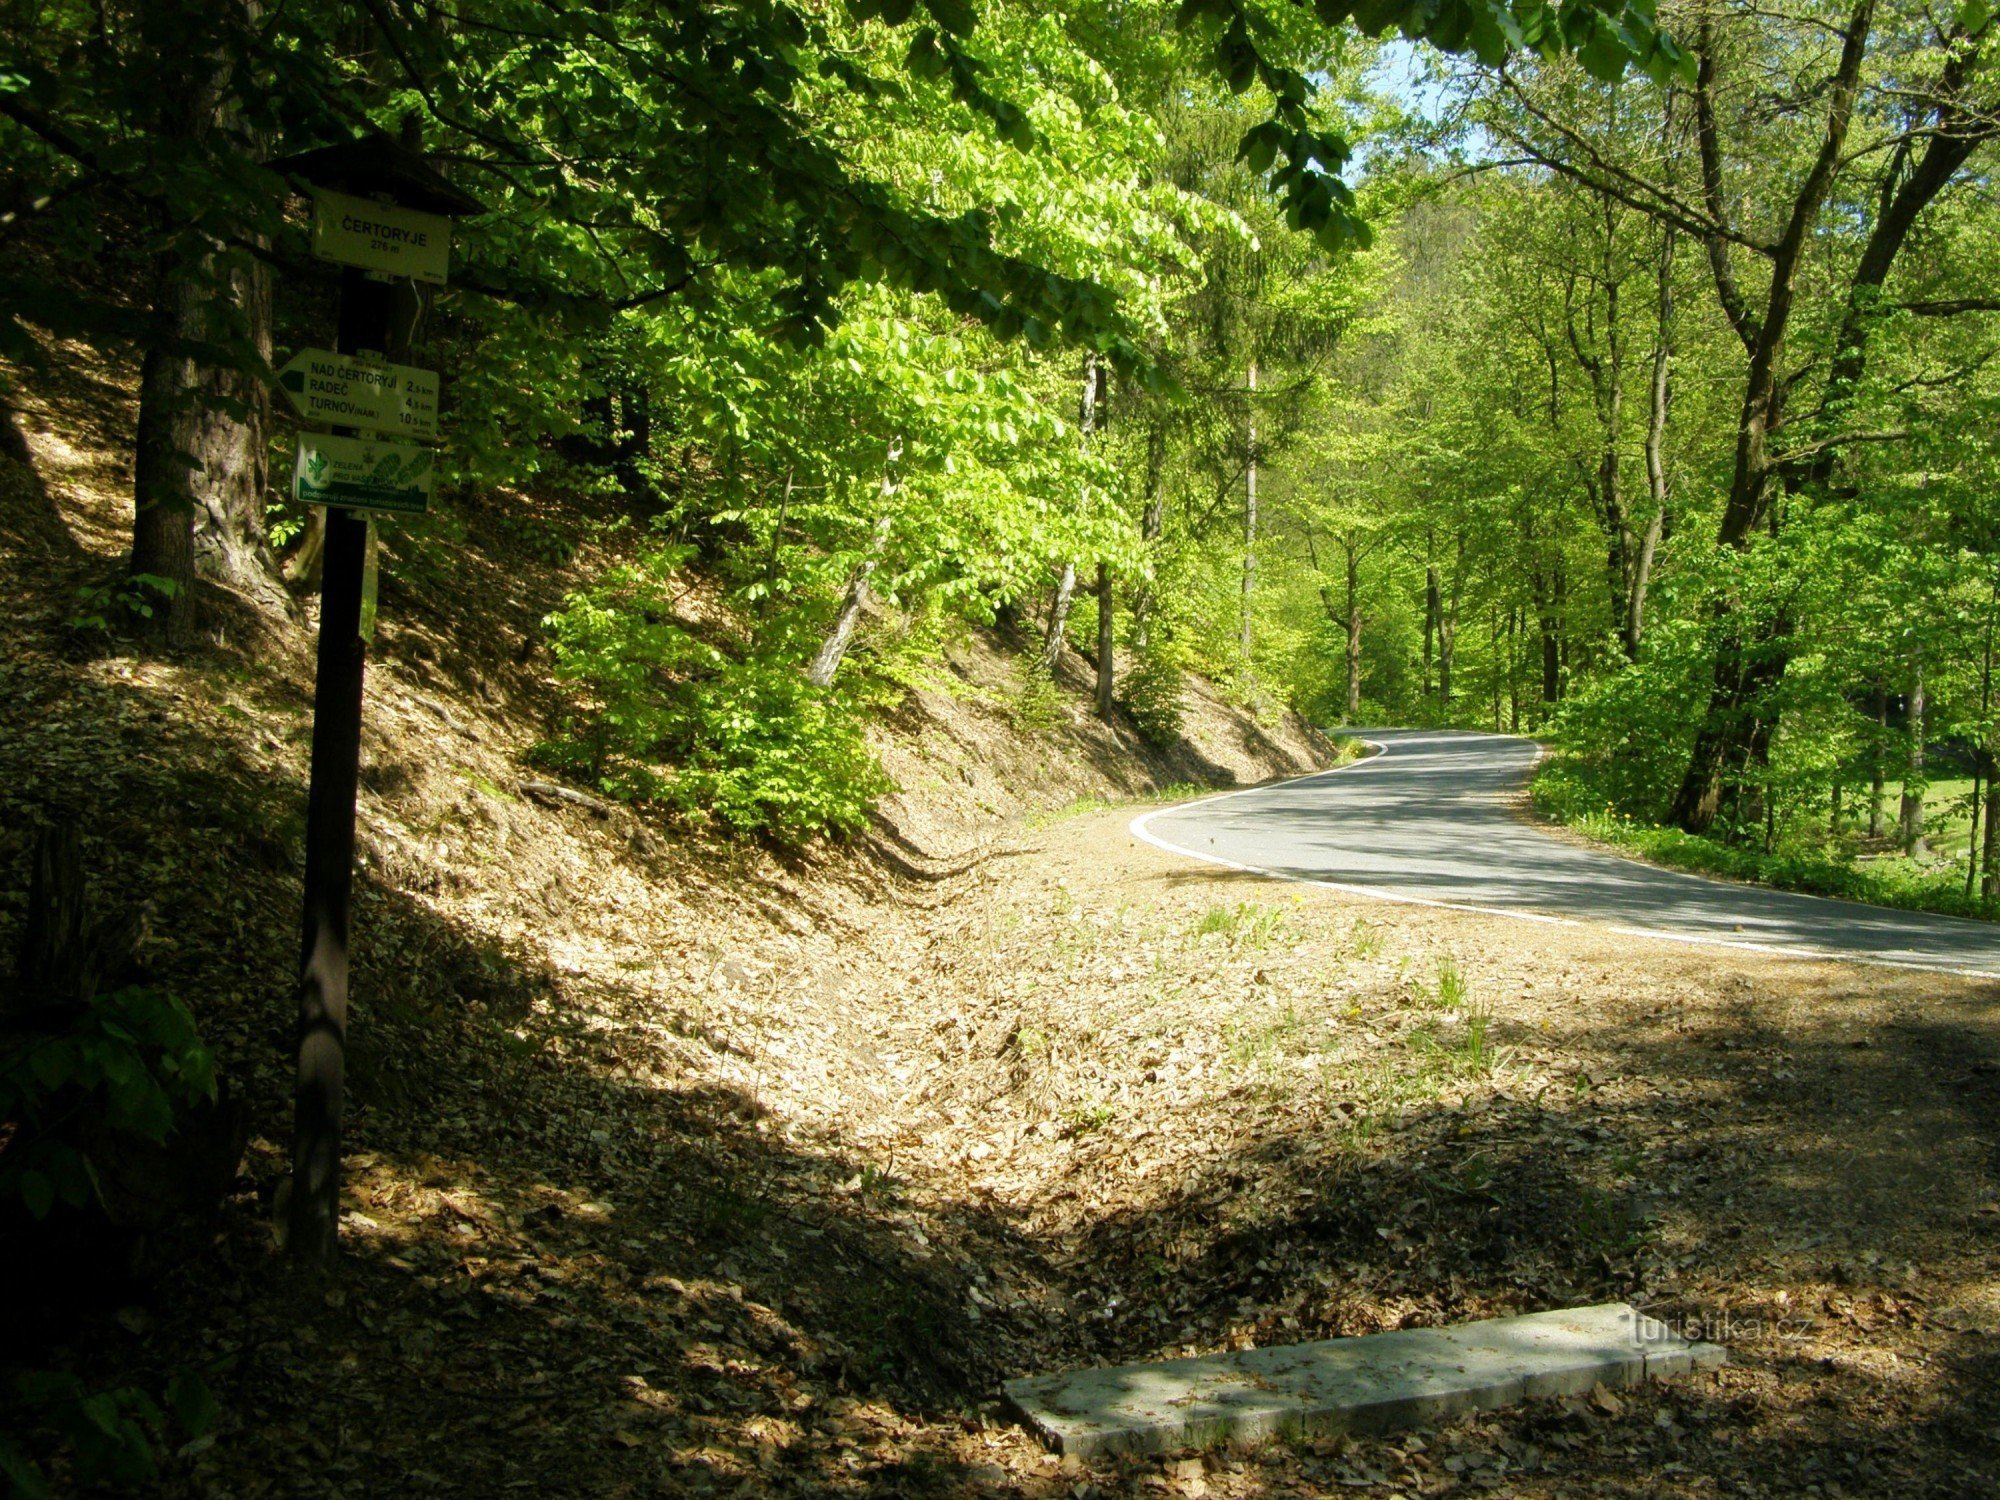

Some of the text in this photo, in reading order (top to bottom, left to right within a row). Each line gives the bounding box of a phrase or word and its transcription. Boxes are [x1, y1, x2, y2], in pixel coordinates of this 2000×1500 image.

[342, 214, 427, 247] ČERTORYJE
[390, 245, 400, 254] m
[310, 379, 349, 396] RADEČ
[421, 402, 432, 411] km
[311, 362, 335, 377] NAD
[337, 365, 397, 389] ČERTORYJÍ
[421, 386, 433, 396] km
[400, 412, 418, 425] 105
[419, 418, 431, 427] km
